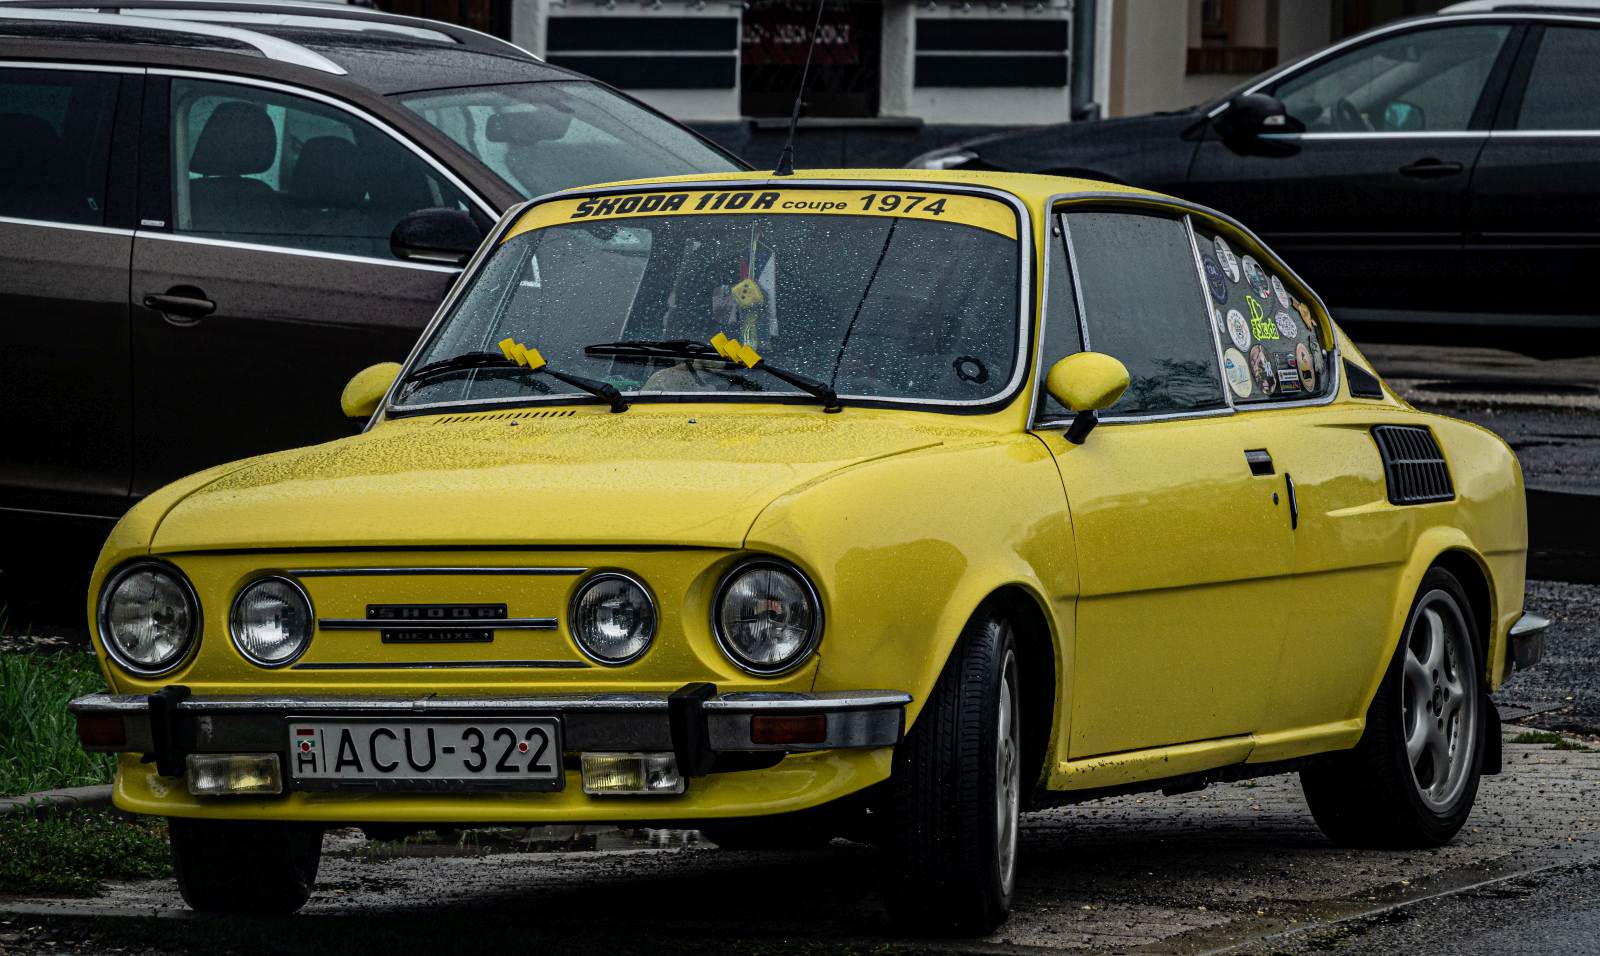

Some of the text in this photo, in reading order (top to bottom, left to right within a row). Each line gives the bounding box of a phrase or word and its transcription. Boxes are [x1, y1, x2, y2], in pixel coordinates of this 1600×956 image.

[781, 200, 848, 212] coupe
[860, 193, 948, 216] 1974
[335, 726, 552, 773] ACU-322
[297, 752, 317, 773] H
